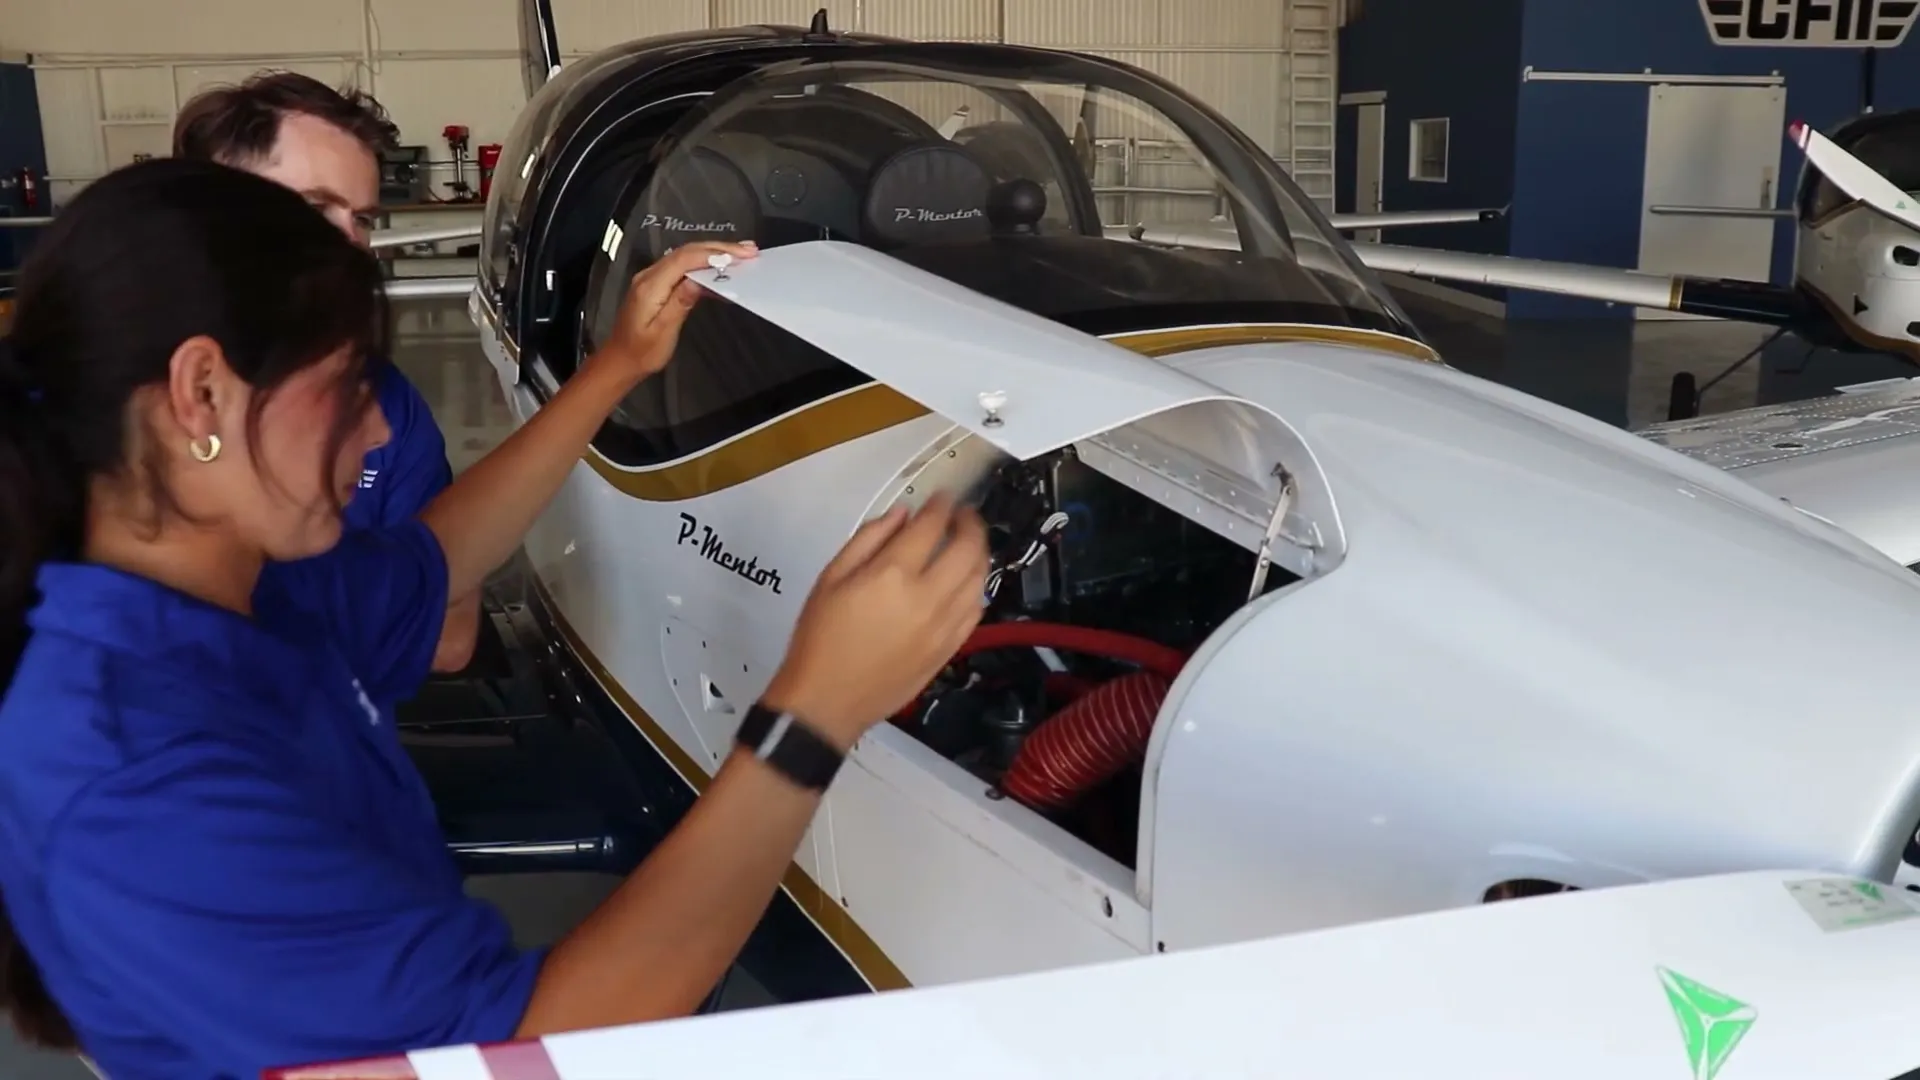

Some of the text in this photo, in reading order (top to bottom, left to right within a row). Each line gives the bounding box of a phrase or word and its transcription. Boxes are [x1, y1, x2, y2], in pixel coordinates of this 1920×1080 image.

[1746, 0, 1875, 40] CFII
[640, 213, 737, 232] P-Mentor
[894, 207, 983, 222] P-Mentor
[677, 511, 782, 595] P-Mentor
